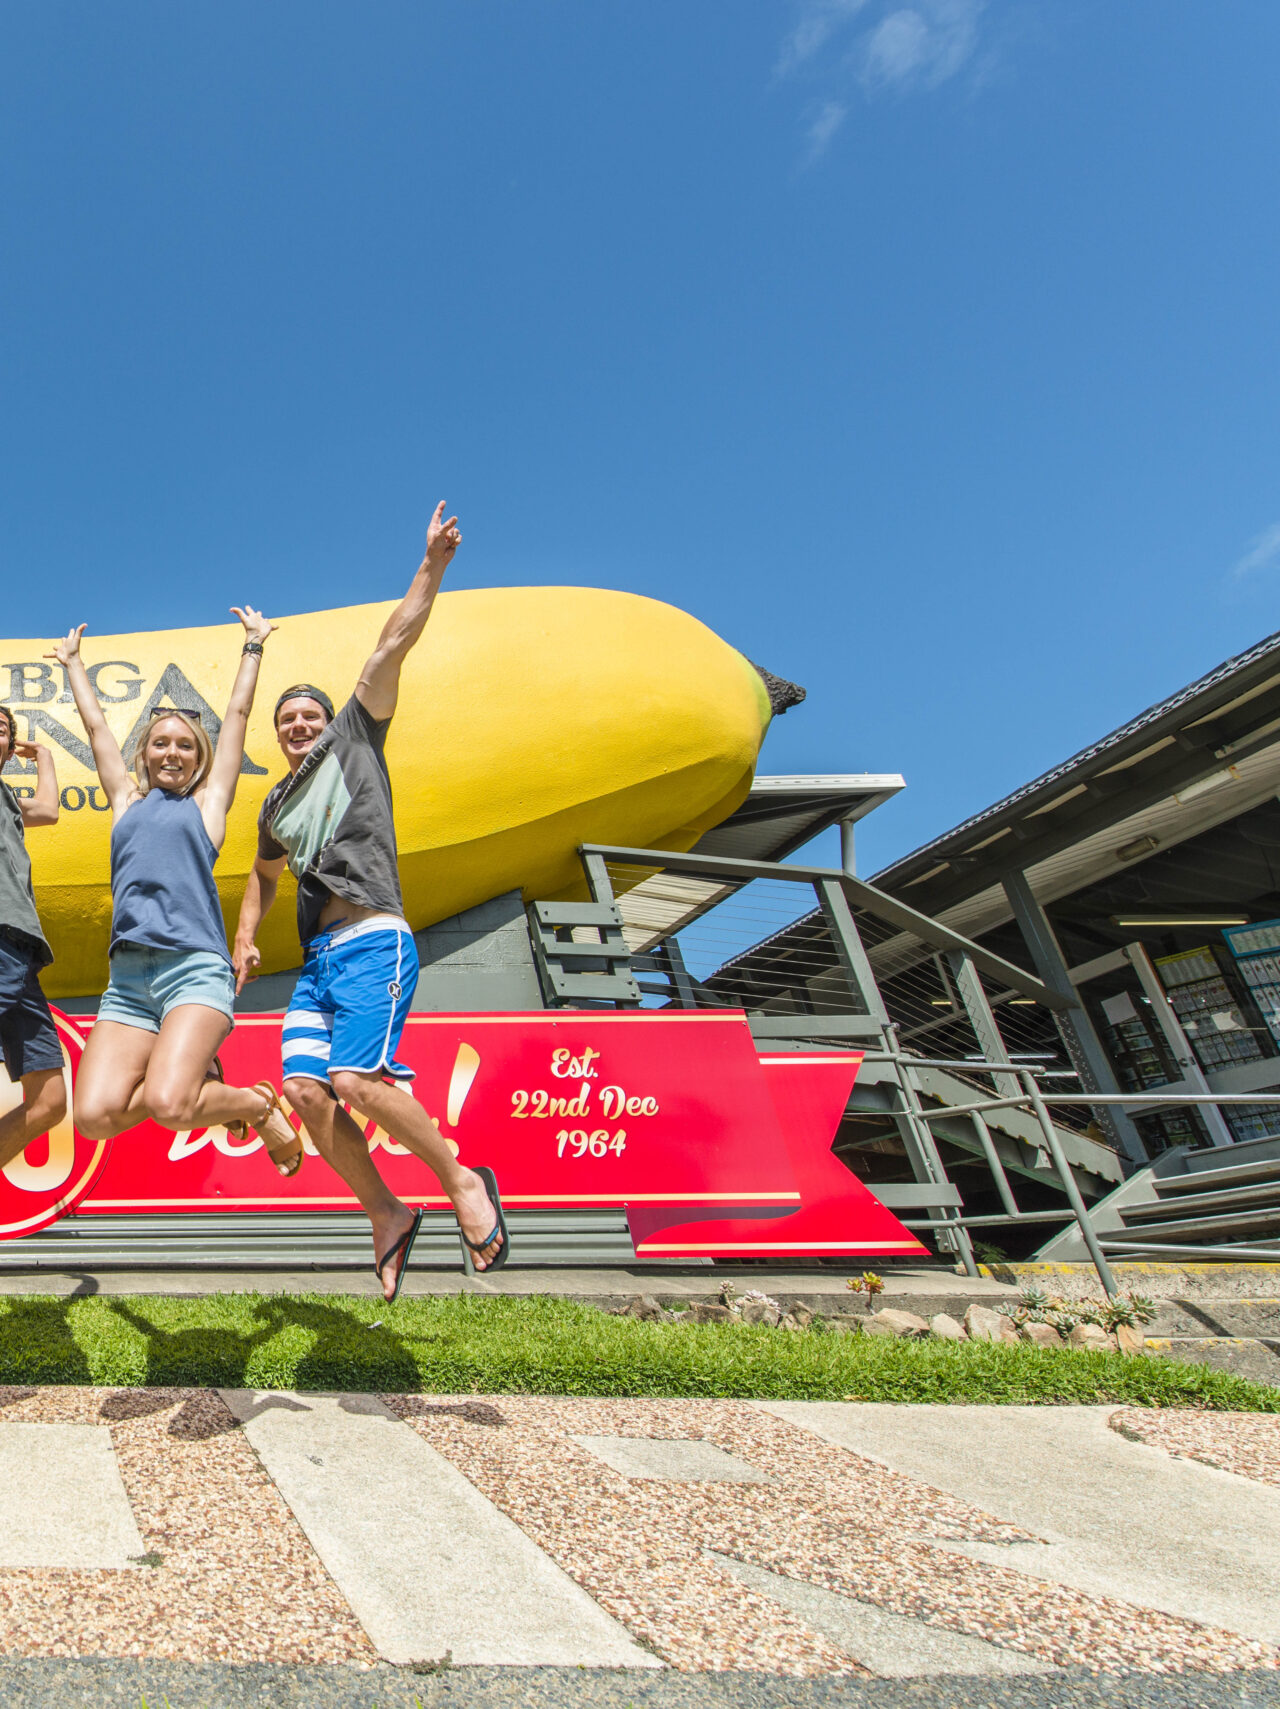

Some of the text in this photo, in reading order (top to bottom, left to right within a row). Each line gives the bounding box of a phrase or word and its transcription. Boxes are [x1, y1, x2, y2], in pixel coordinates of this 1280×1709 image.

[0, 660, 147, 704] BIG
[550, 1046, 601, 1079] Est.
[510, 1081, 660, 1120] 22nd Dec
[555, 1128, 627, 1158] 1964
